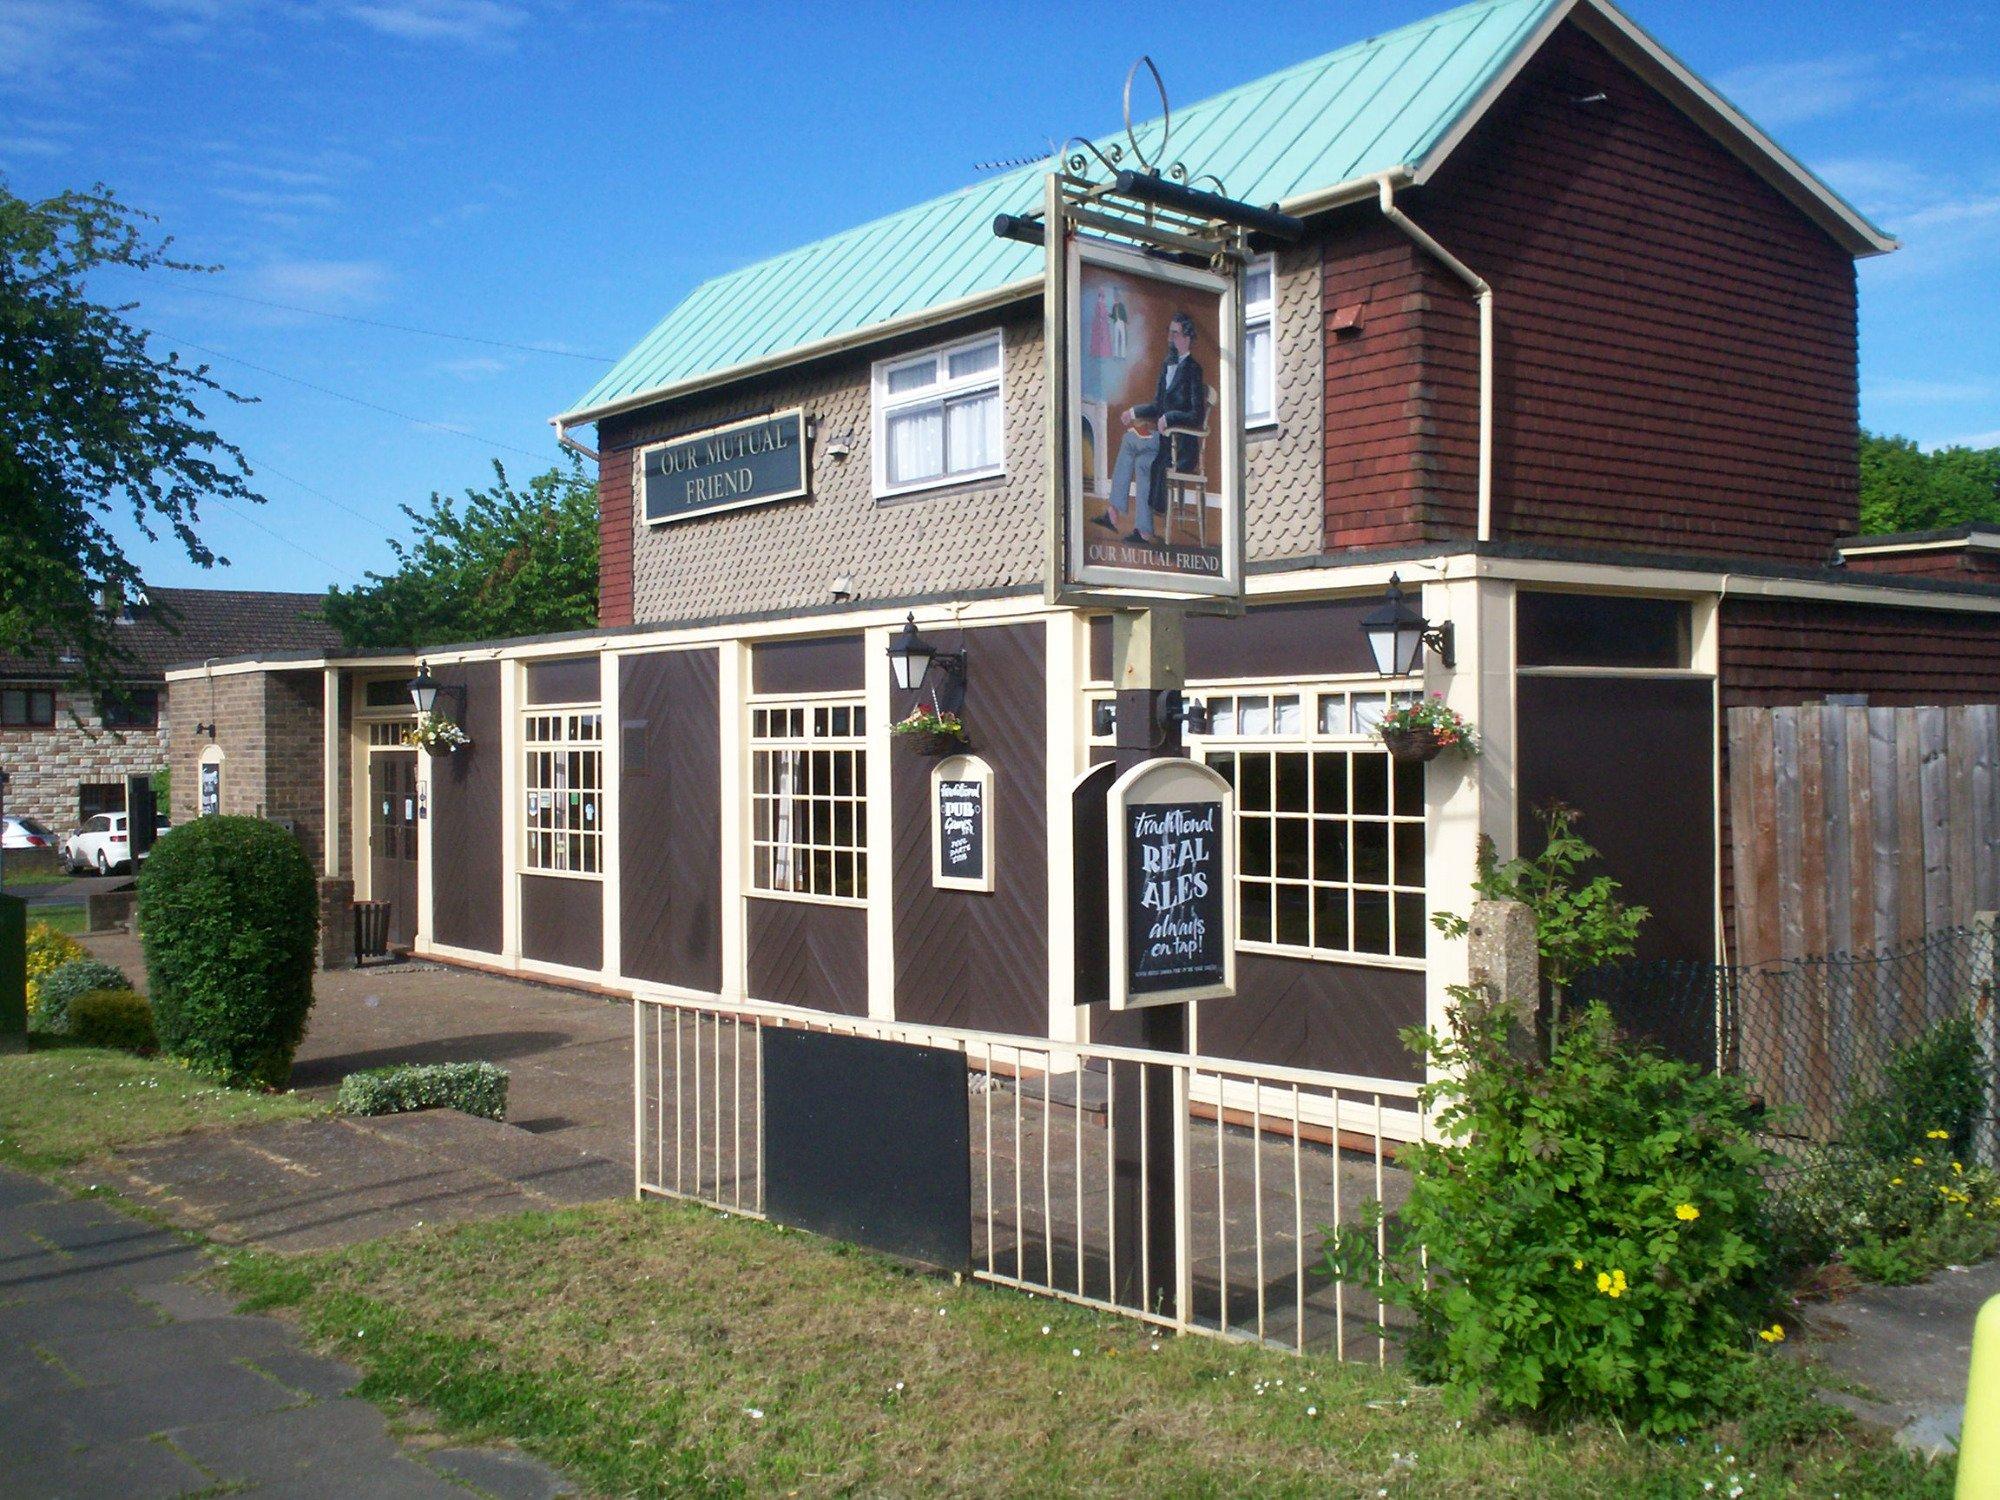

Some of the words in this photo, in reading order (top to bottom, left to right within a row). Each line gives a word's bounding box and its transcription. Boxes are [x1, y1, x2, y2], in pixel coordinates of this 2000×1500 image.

[661, 446, 699, 476] OUR
[706, 425, 787, 465] MUTUAL
[686, 468, 753, 504] FRIEND
[1089, 544, 1117, 562] OUR
[1121, 547, 1173, 567] MUTUAL
[1176, 553, 1219, 572] FRIEND
[944, 801, 975, 818] PUB
[1142, 838, 1209, 873] REAL
[1141, 872, 1209, 911] ALES
[1149, 914, 1206, 940] always
[1151, 940, 1171, 958] on
[1173, 934, 1204, 960] tap!
